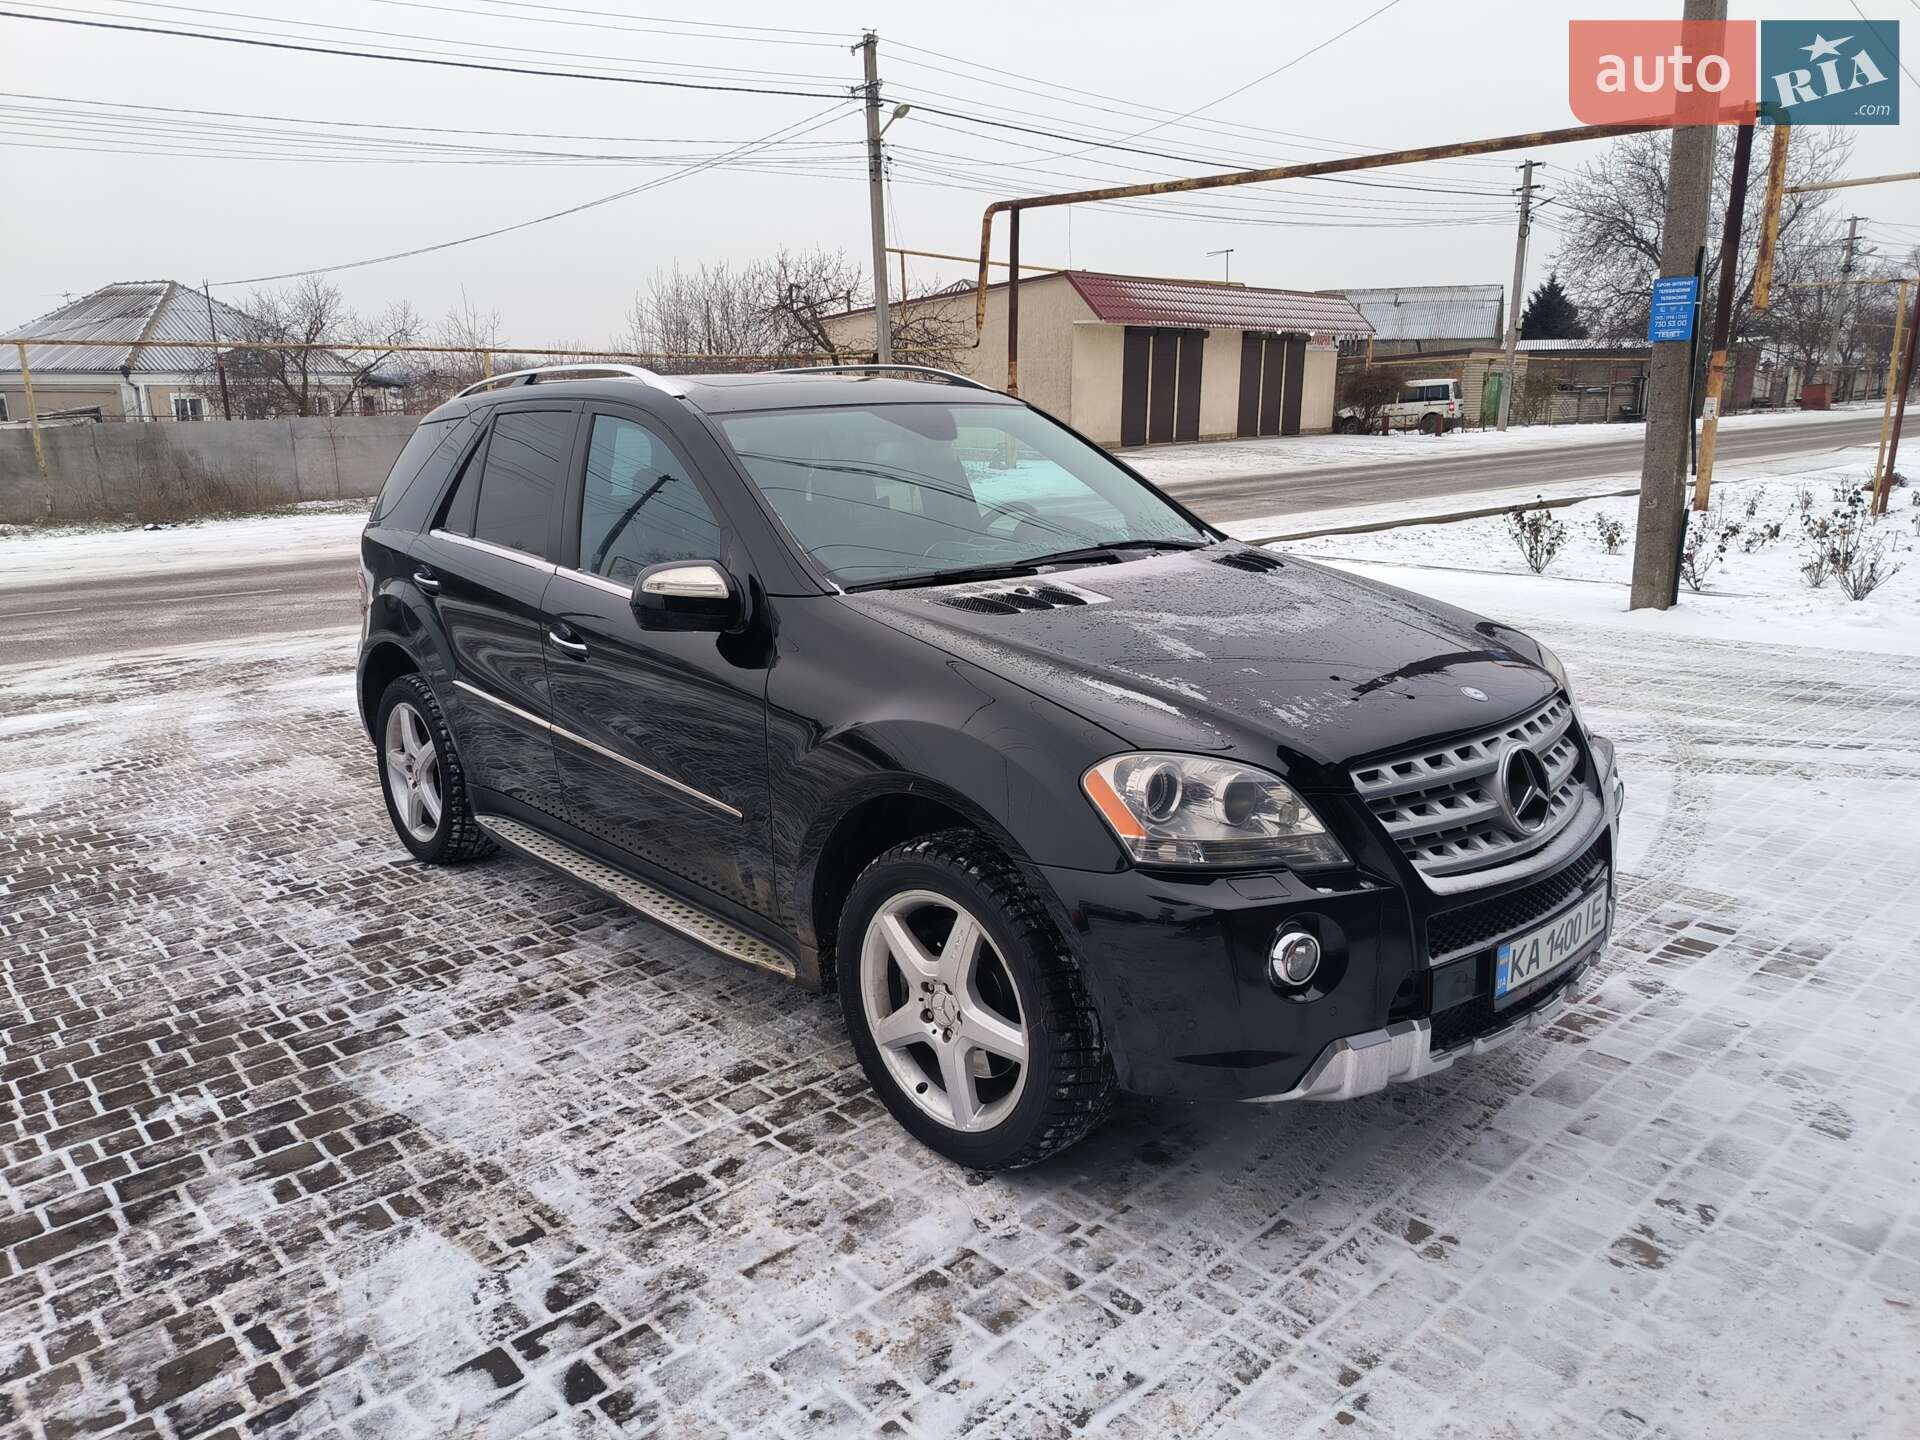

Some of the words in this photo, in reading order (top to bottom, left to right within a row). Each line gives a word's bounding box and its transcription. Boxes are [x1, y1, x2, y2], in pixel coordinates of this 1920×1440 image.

[1510, 938, 1540, 983] KA
[1547, 911, 1582, 962] 1400
[1585, 893, 1603, 936] IE
[1497, 977, 1507, 989] UA
